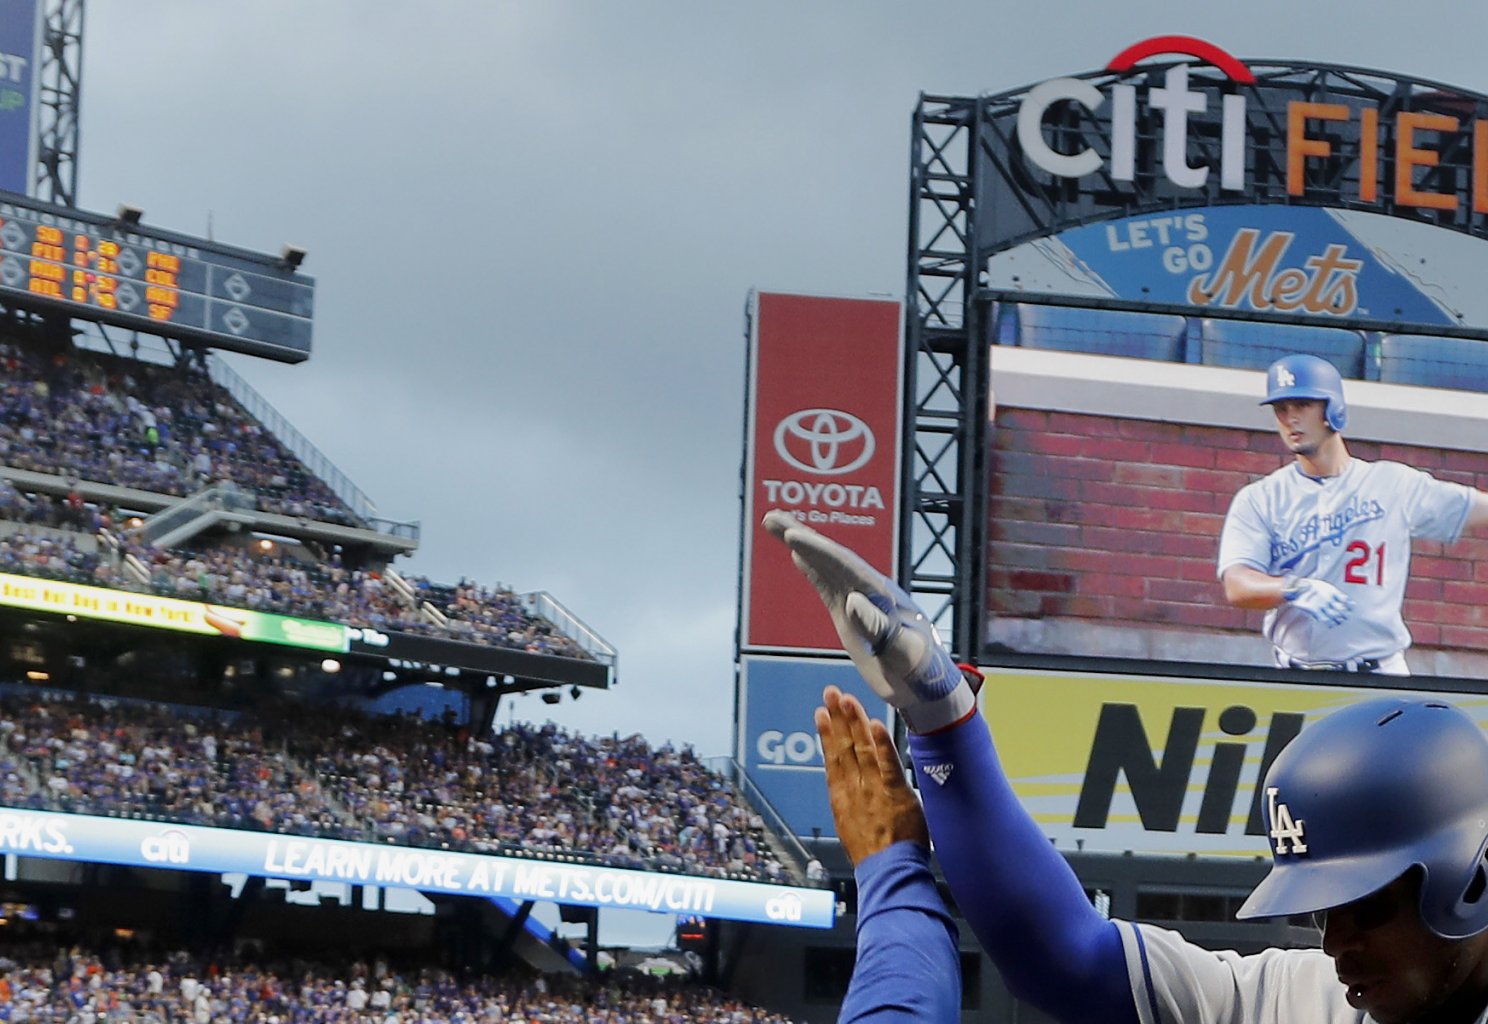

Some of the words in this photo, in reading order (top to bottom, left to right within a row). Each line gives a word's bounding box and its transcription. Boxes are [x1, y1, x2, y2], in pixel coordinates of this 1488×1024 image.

[1018, 63, 1247, 191] citi
[1106, 214, 1210, 252] LET'S
[1163, 245, 1213, 274] GO
[1188, 227, 1365, 317] Mets
[761, 480, 886, 510] TOYOTA
[807, 510, 829, 523] Go
[829, 511, 877, 526] Places
[1344, 538, 1386, 586] 21
[1267, 787, 1308, 854] LA
[264, 839, 370, 881] LEARN
[374, 846, 463, 890] MORE
[467, 858, 507, 893] AT
[513, 864, 715, 912] METS.COM/CITI
